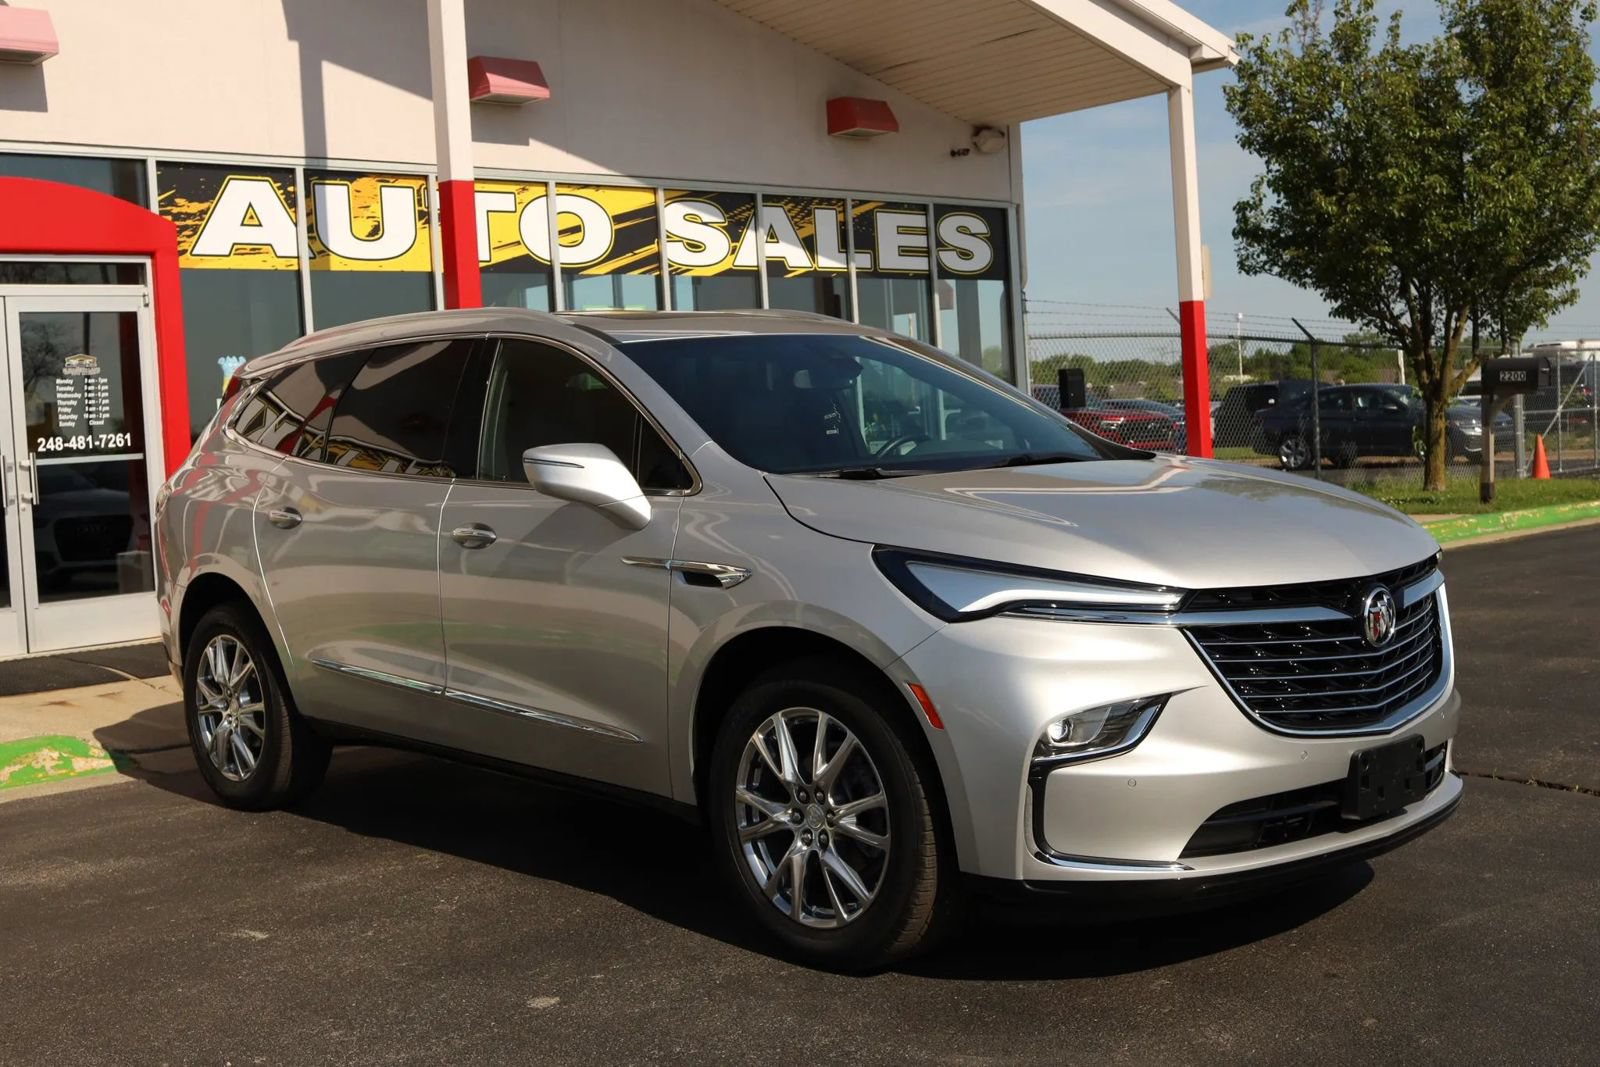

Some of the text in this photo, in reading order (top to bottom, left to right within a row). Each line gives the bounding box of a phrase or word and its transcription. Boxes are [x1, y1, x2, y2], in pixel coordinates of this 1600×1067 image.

[663, 199, 993, 274] SALES
[1500, 371, 1526, 381] 2200
[37, 433, 131, 452] 248-481-7261
